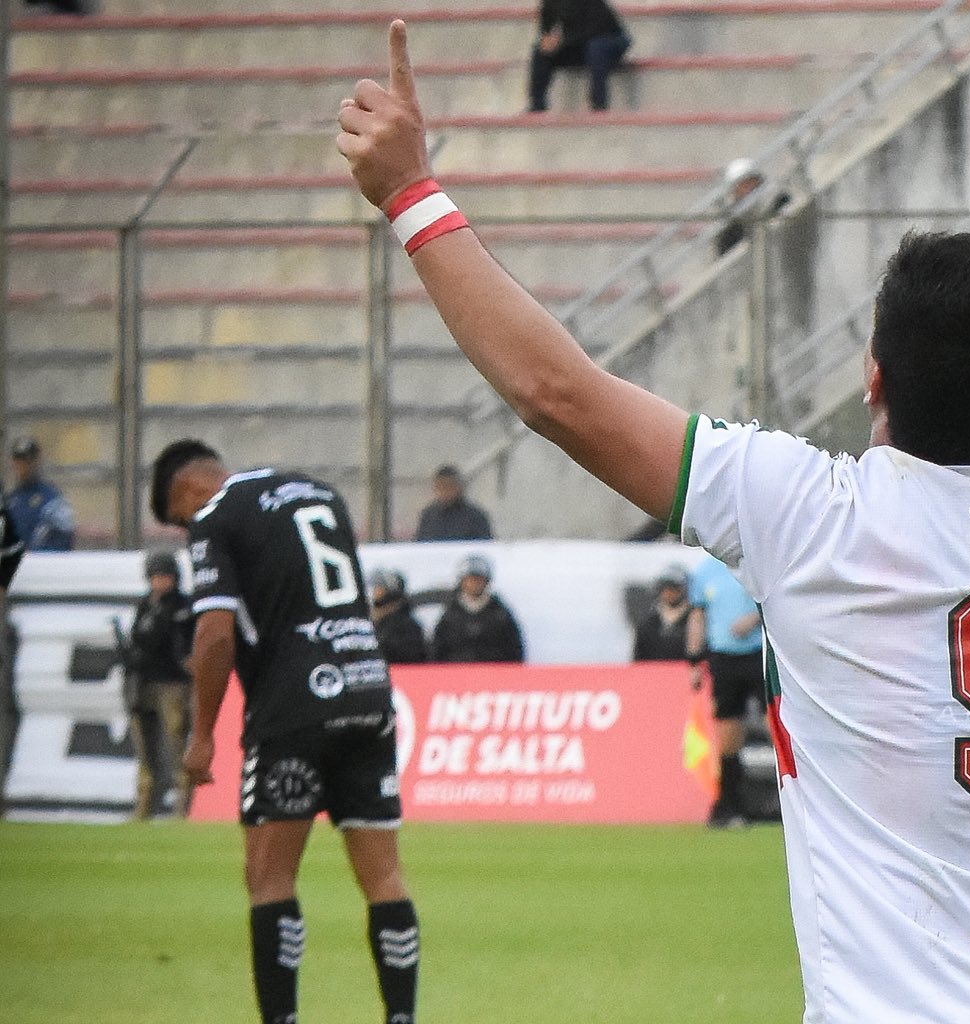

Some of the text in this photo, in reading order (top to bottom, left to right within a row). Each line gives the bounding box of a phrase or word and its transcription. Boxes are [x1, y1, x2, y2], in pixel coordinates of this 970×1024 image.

[293, 504, 359, 608] 6
[428, 688, 621, 731] INSTITUTO
[418, 734, 586, 775] DE SALTA
[510, 779, 541, 805] DE
[543, 779, 596, 805] VIDA
